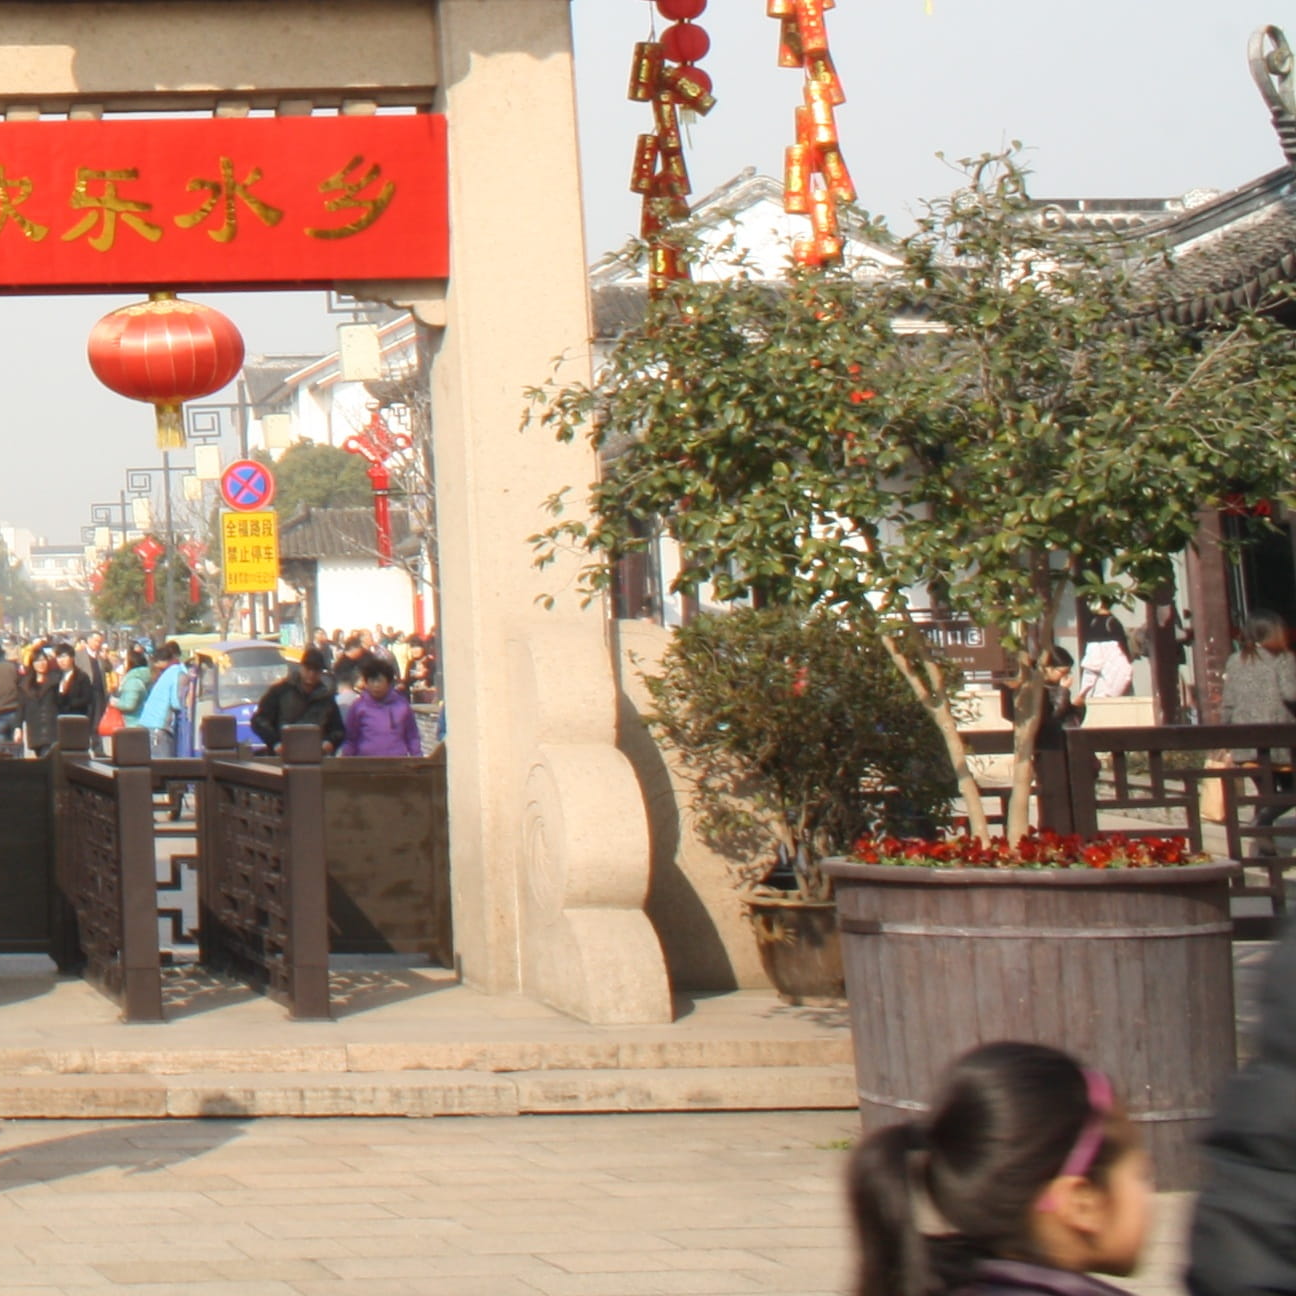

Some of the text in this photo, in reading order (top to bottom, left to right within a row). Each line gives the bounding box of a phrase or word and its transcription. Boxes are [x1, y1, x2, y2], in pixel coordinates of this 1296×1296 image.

[226, 519, 273, 538] 全福路段
[227, 545, 274, 563] 禁止停车
